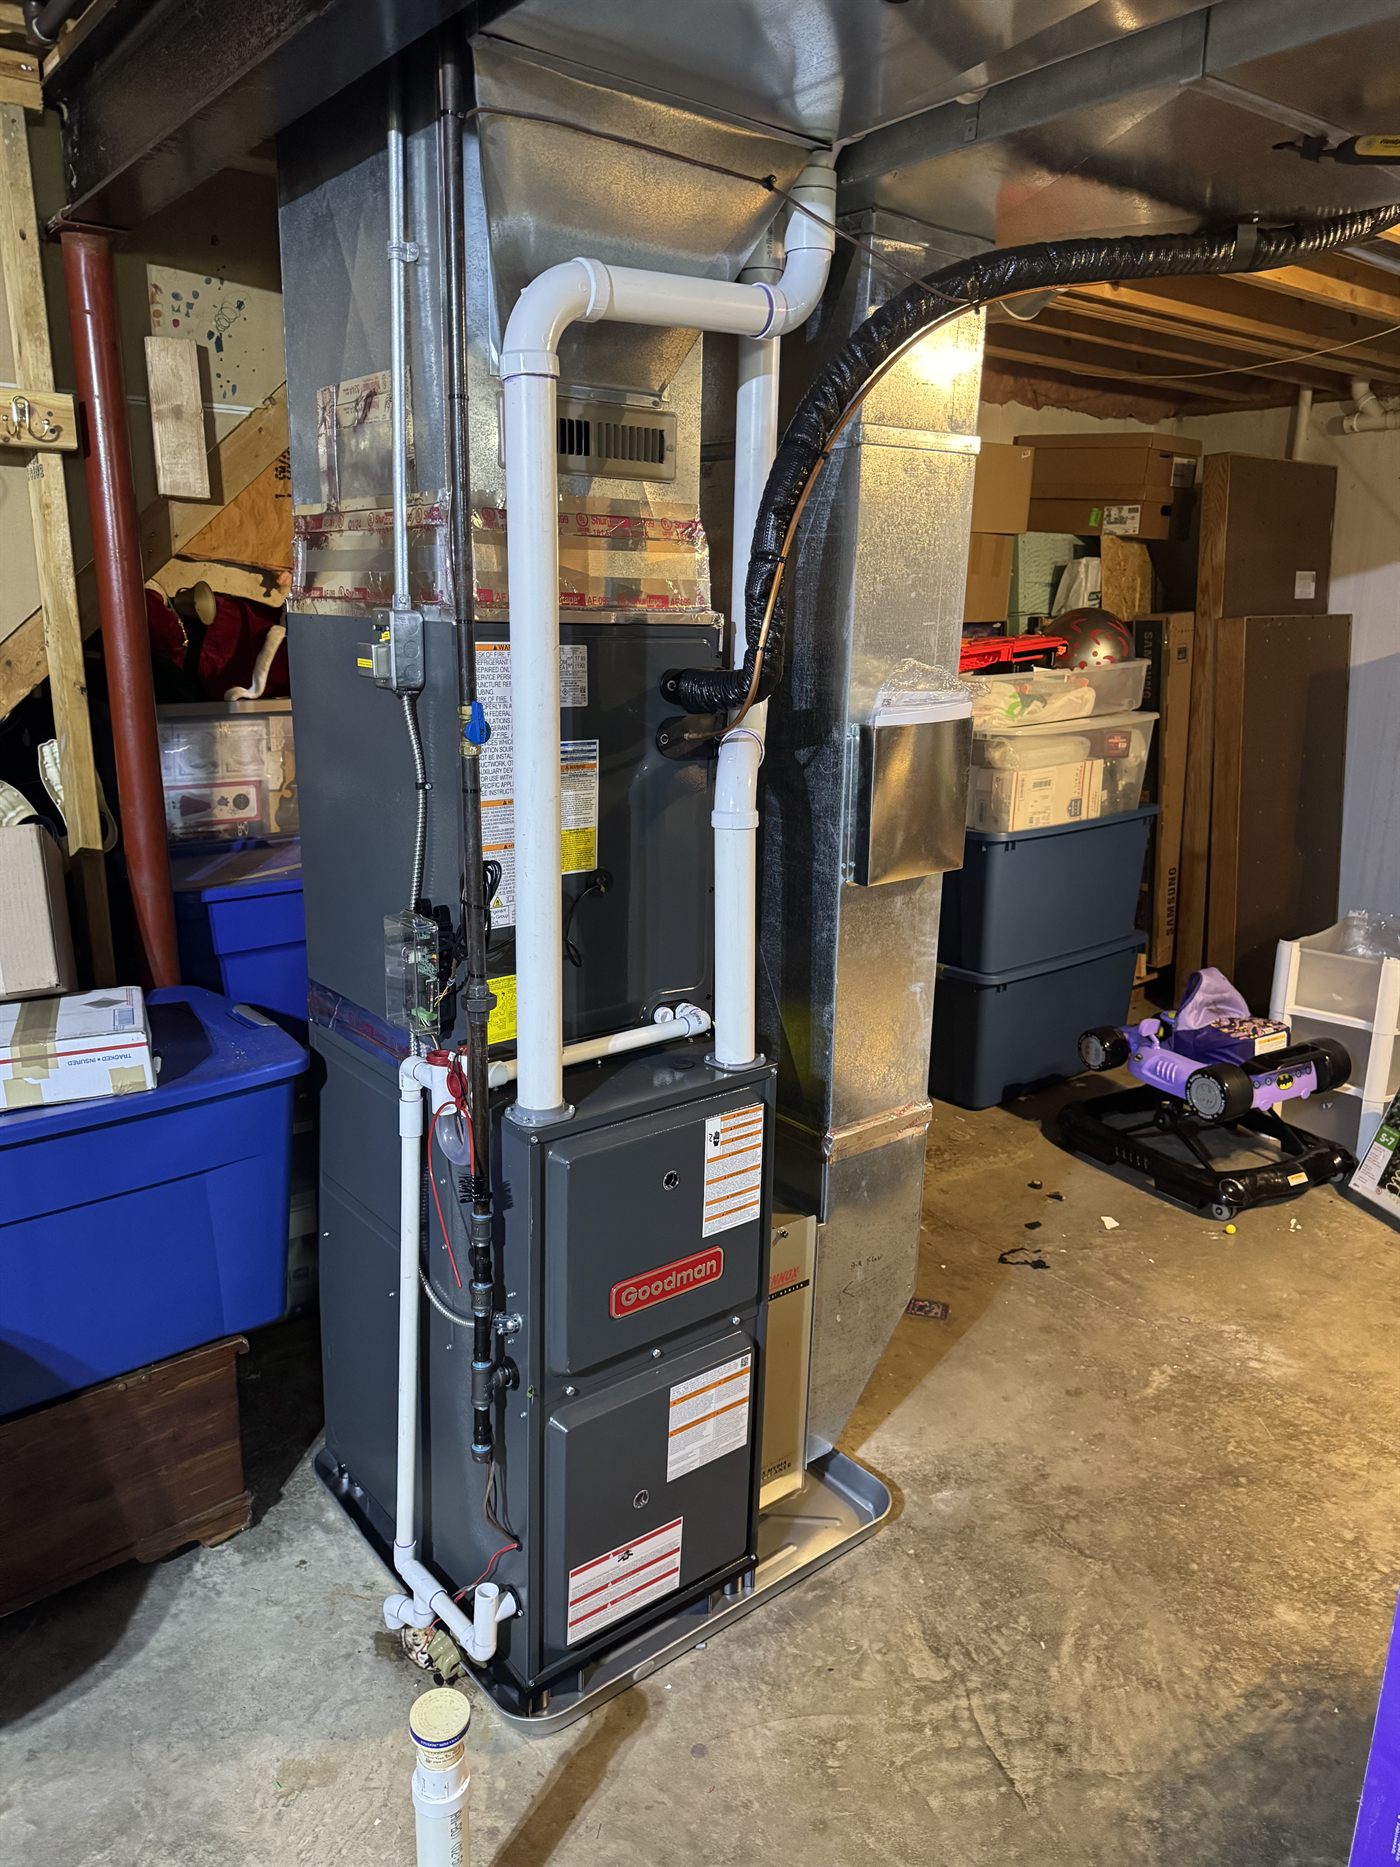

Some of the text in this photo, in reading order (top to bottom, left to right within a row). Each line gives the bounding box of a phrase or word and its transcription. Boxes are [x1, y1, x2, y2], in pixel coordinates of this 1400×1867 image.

[1166, 866, 1177, 936] SAMSUNG
[67, 1052, 132, 1066] TRACKED INSURED
[1380, 1132, 1396, 1146] S-7
[621, 1260, 716, 1306] Goodman
